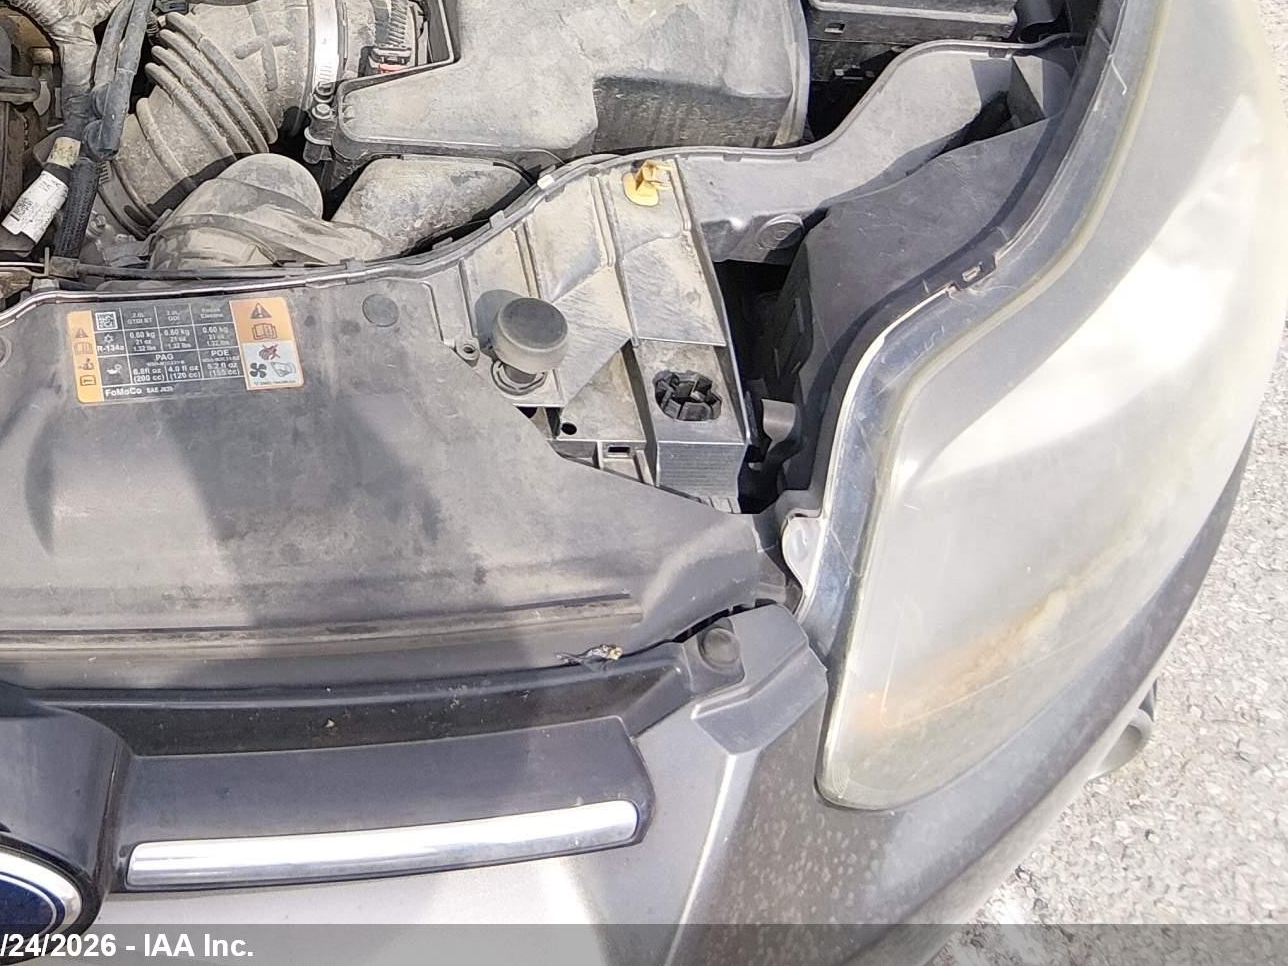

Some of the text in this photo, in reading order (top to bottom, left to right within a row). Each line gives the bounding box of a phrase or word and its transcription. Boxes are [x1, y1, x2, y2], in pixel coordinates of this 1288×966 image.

[97, 344, 125, 353] R-134a
[155, 353, 174, 361] PAG
[210, 349, 230, 357] POE
[105, 387, 143, 397] FoMoCo
